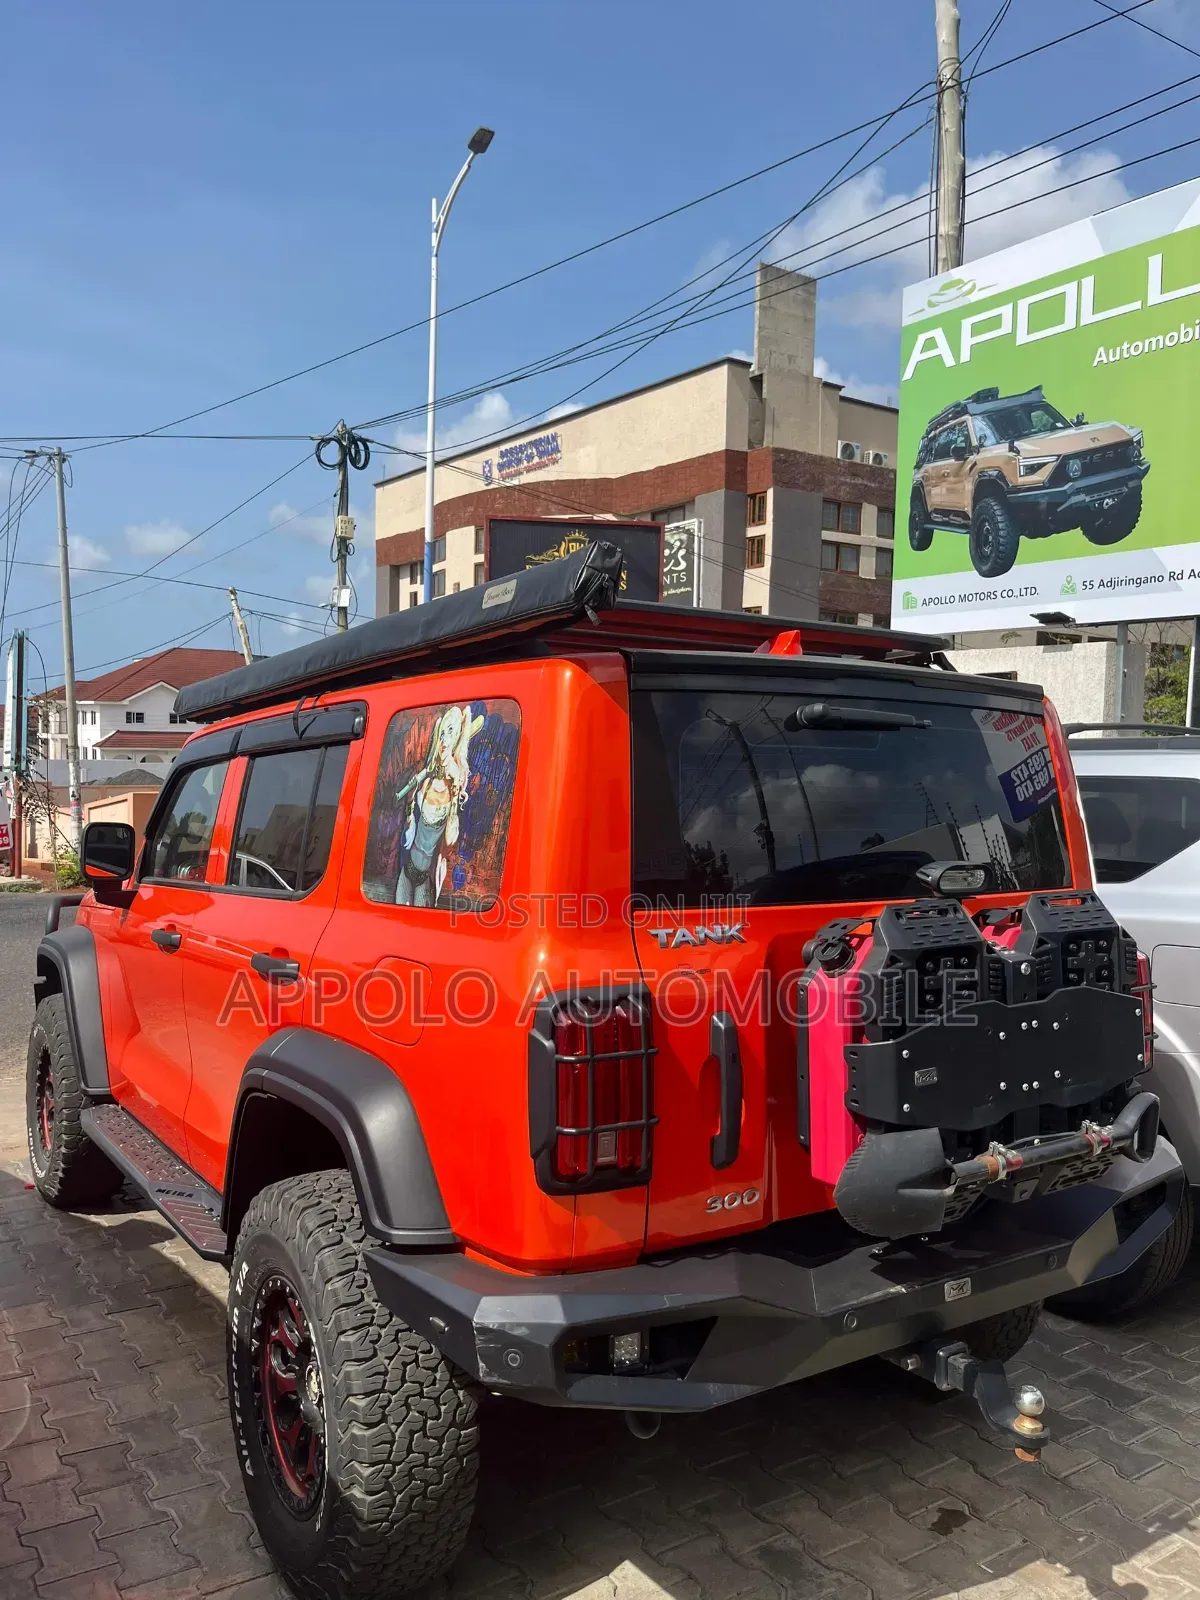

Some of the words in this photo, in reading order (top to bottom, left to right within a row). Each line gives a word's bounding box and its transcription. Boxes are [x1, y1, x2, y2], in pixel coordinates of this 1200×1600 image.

[1093, 319, 1200, 367] Automobi
[1081, 580, 1095, 591] 55
[1097, 574, 1165, 591] Adjiringano
[1168, 569, 1184, 582] Rd
[921, 595, 956, 608] APOLLO
[958, 590, 998, 603] MOTORS
[1000, 586, 1040, 599] CO.,LTD.
[647, 923, 747, 949] TANK
[155, 1188, 194, 1198] MEIKA
[704, 1188, 760, 1214] 300
